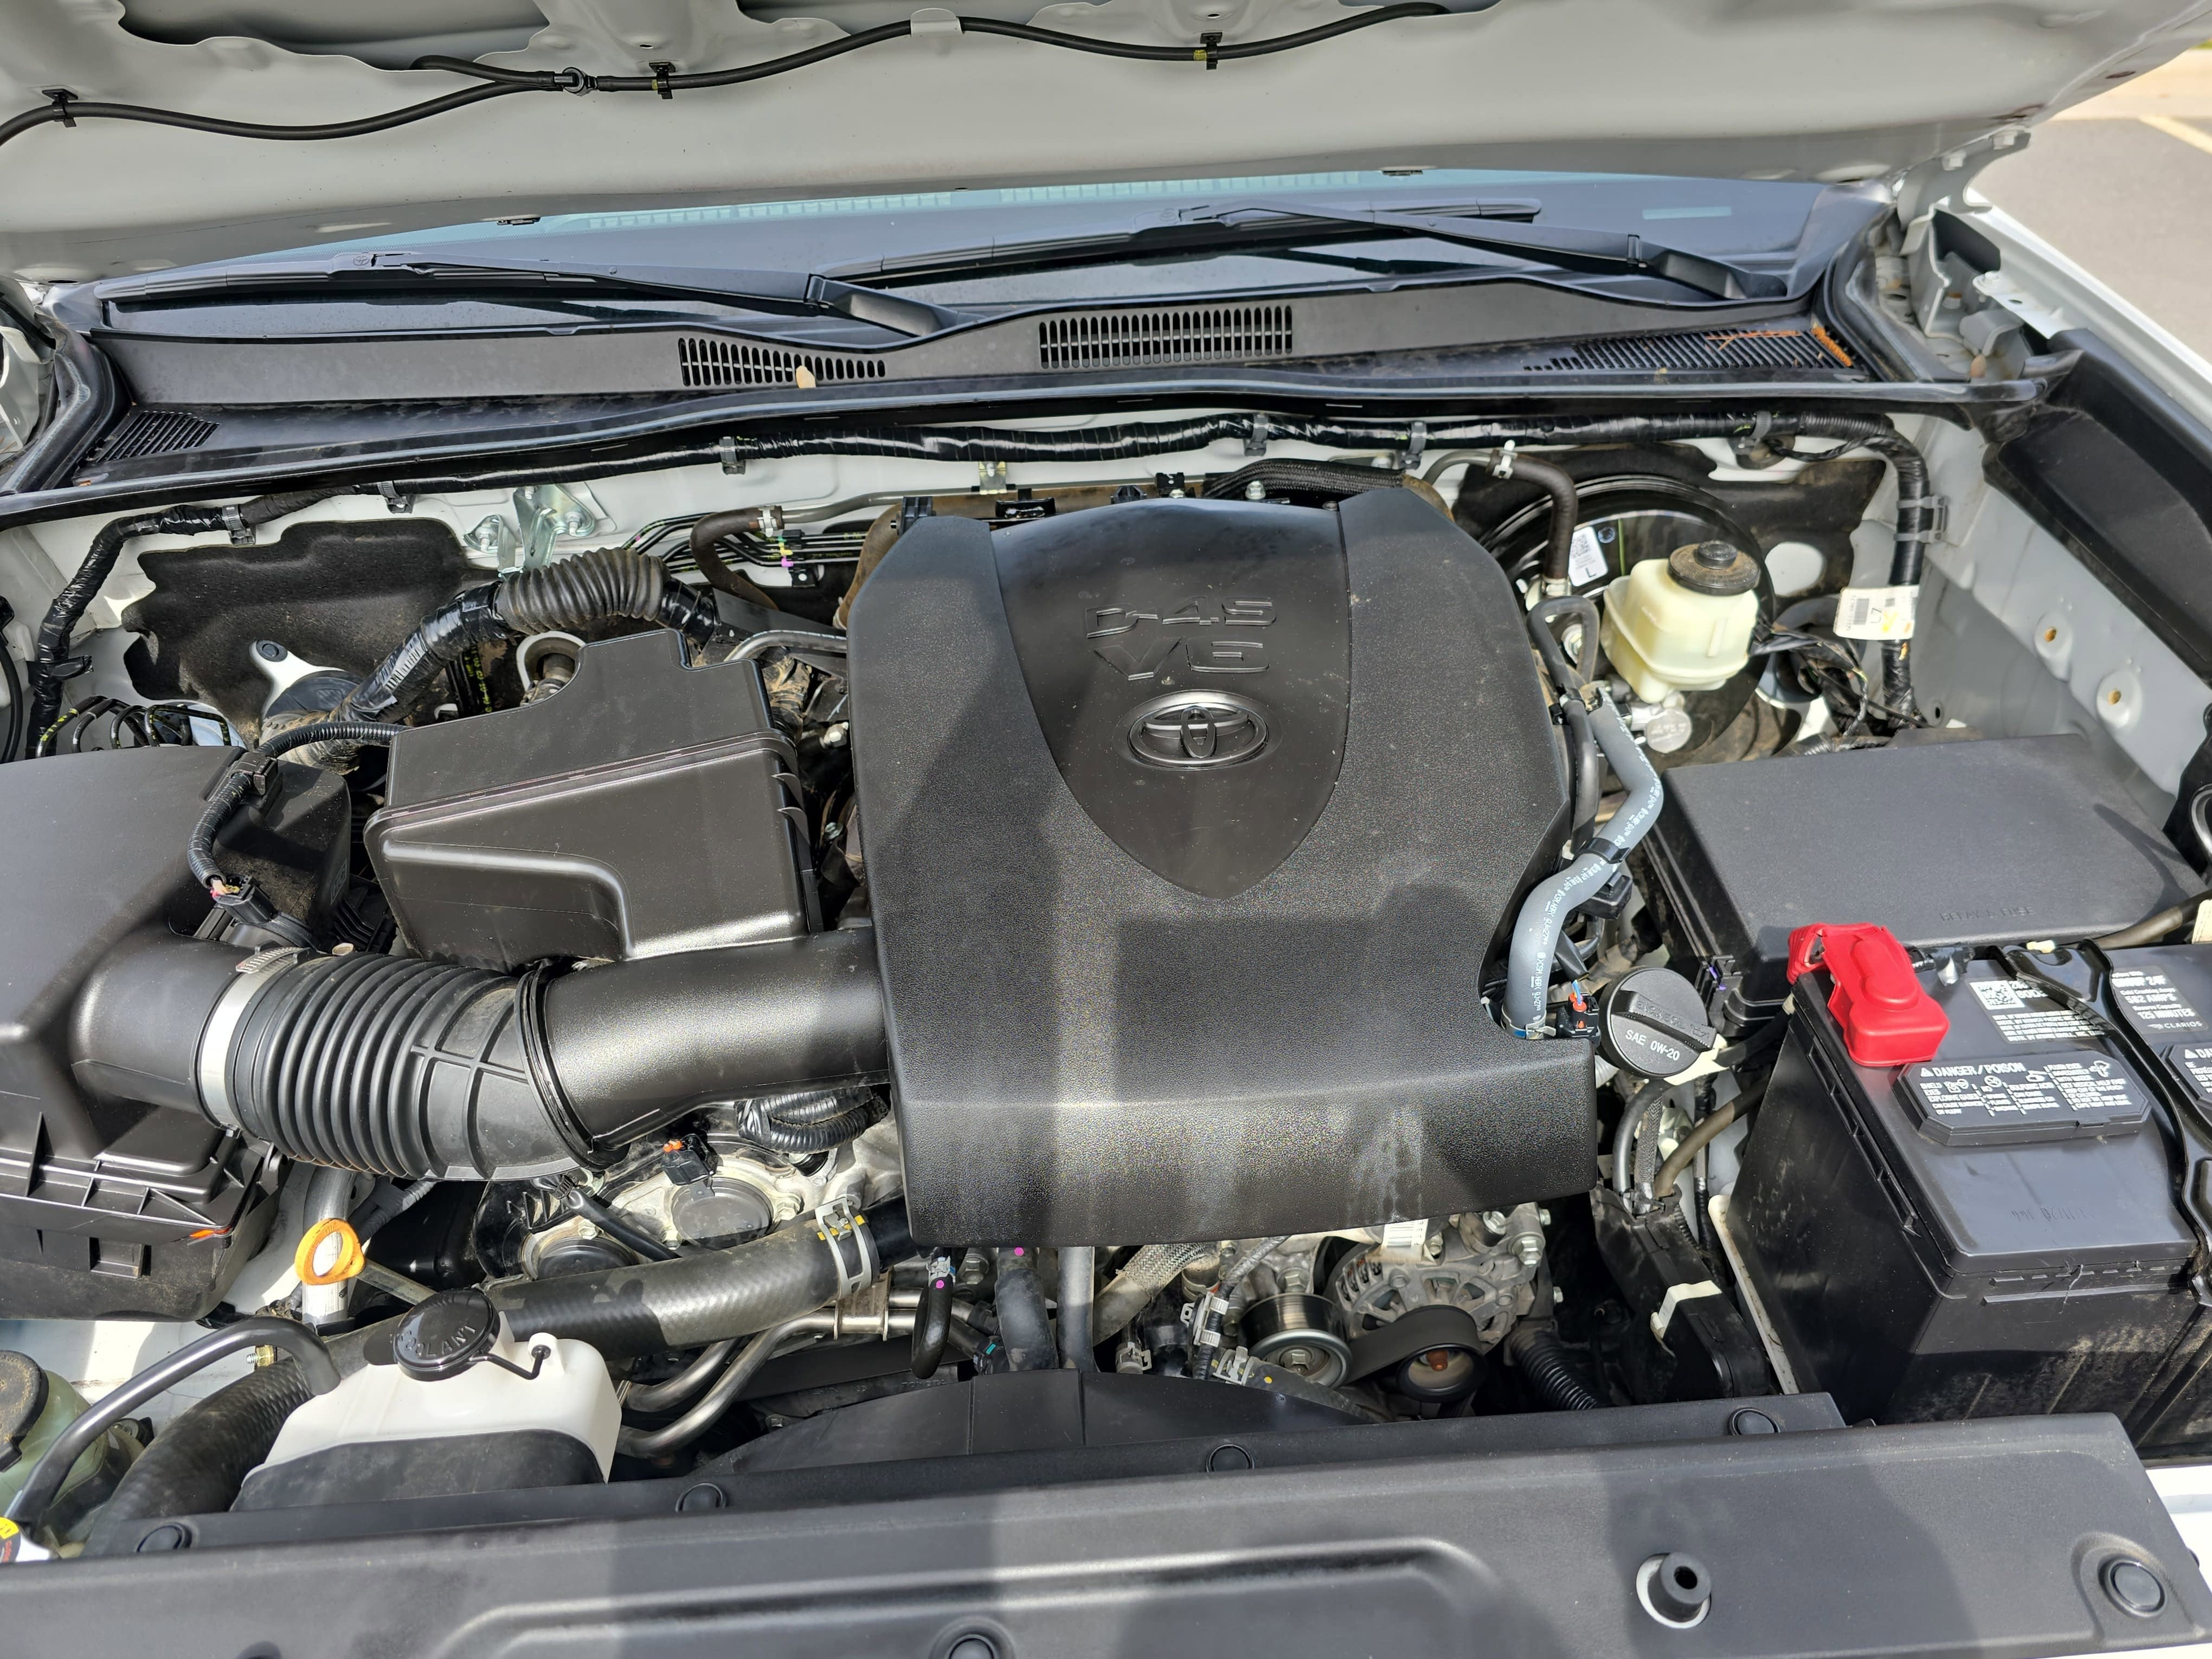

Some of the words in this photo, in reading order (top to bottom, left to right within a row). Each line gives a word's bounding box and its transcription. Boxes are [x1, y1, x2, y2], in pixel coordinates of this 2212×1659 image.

[1085, 595, 1277, 639] D-4S
[1093, 636, 1270, 681] V6
[1939, 911, 1979, 922] RELAY
[2000, 906, 2035, 917] FUSE
[2145, 993, 2177, 1003] AMPS
[2137, 1011, 2156, 1019] 125
[2153, 1008, 2196, 1019] MINUTES
[1625, 1029, 1647, 1046] SAE
[1650, 1040, 1680, 1062] 0W-20
[1932, 1065, 1978, 1077] DANGER
[1983, 1062, 2027, 1074] POISON
[1927, 1094, 1960, 1103] EXPLOSIVE
[400, 1325, 476, 1358] COOLANT
